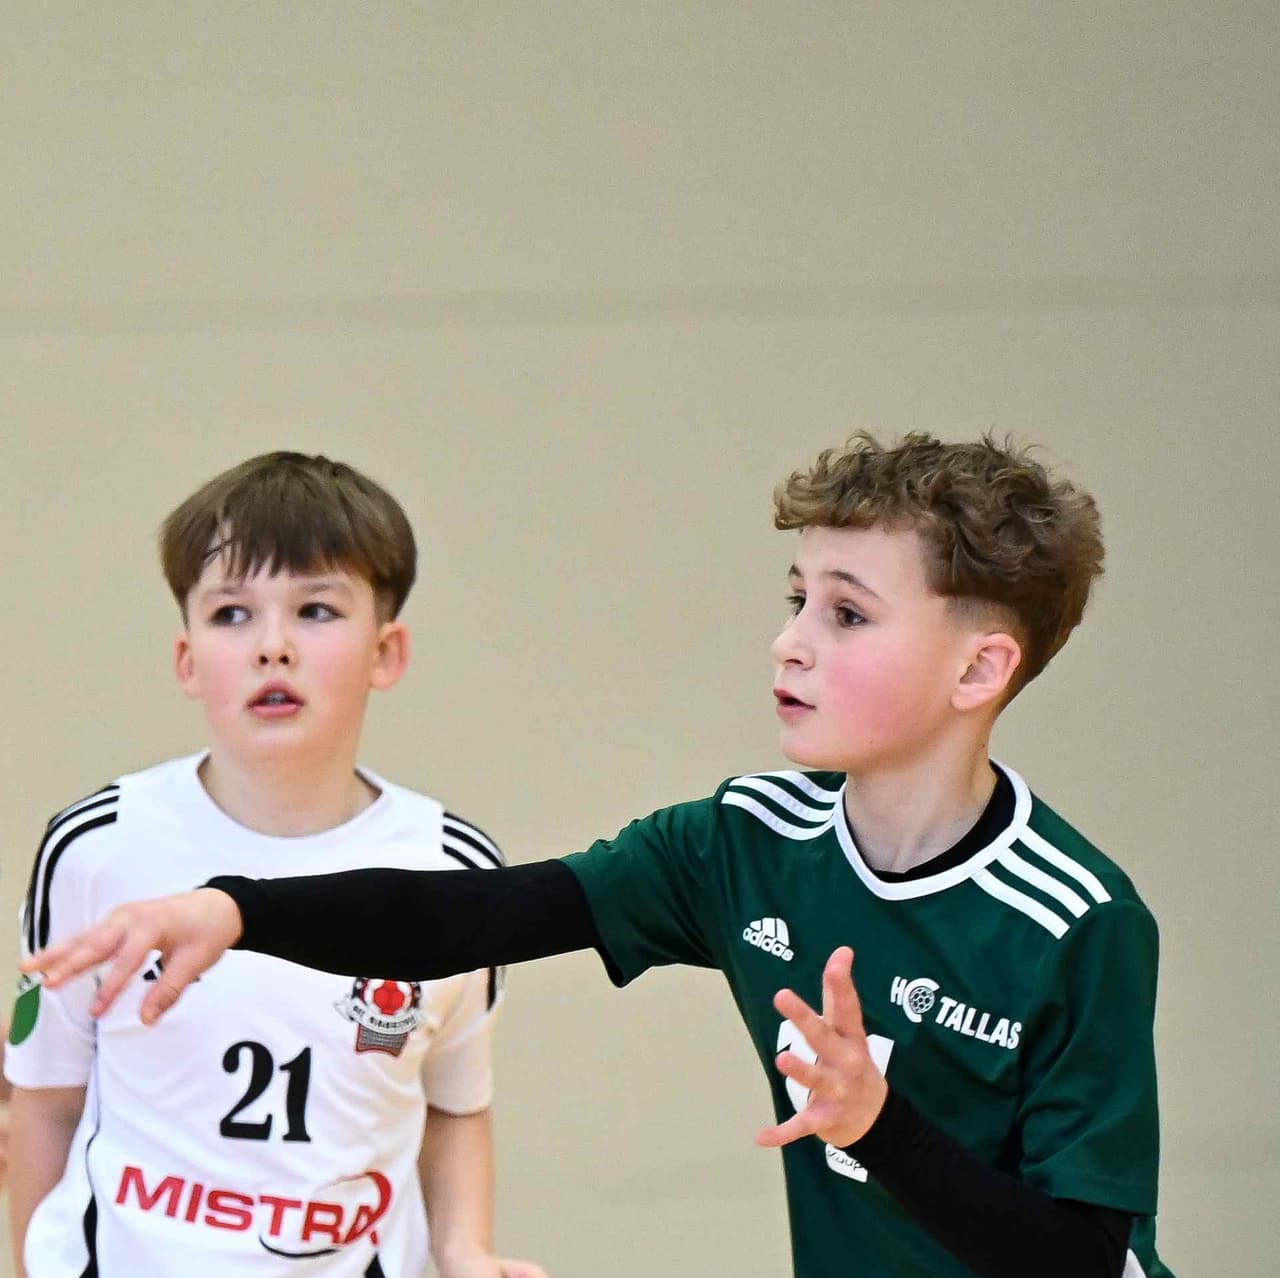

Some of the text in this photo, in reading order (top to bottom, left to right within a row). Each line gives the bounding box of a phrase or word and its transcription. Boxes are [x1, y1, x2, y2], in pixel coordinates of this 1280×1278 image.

[742, 927, 794, 961] adidas
[935, 995, 1023, 1050] TALLAS
[220, 1040, 312, 1142] 21
[115, 1165, 392, 1247] MISTRA
